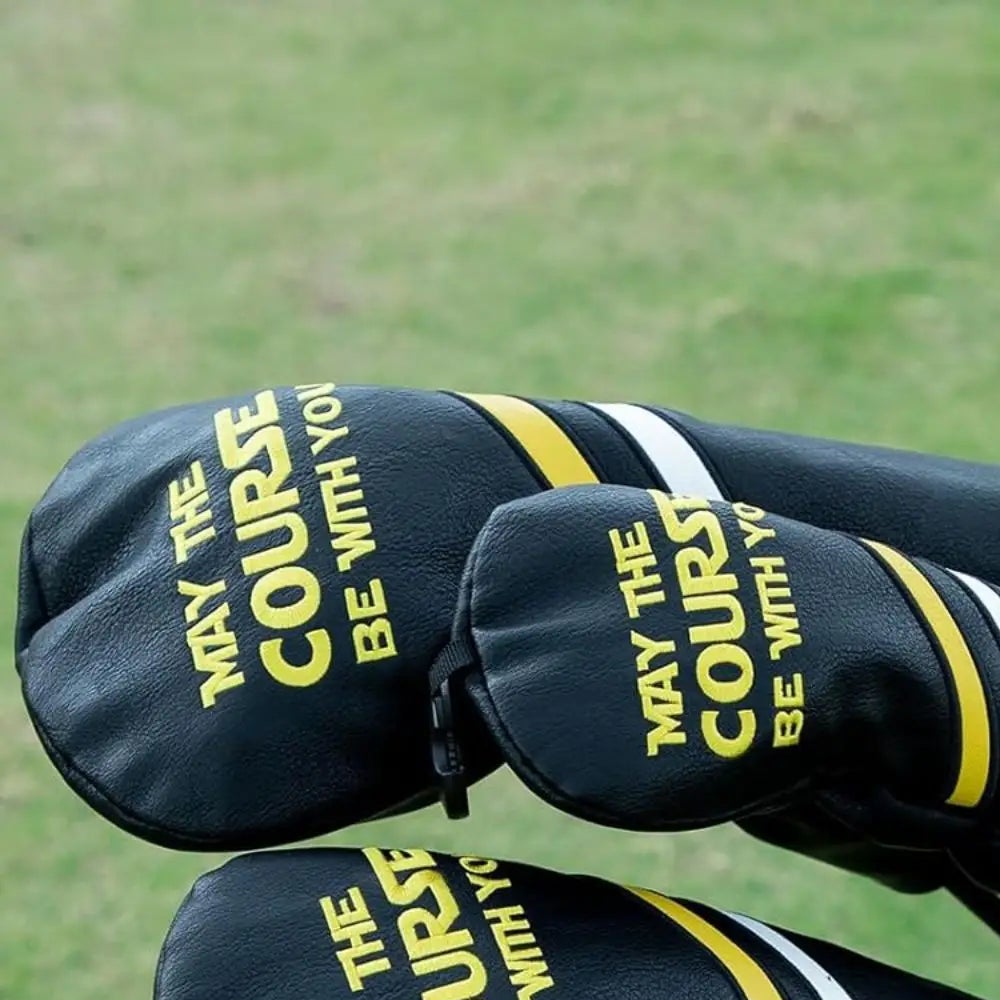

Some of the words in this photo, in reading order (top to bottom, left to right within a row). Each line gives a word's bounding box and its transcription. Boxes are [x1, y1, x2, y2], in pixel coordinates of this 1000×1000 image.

[168, 460, 216, 564] THE
[213, 389, 332, 687] COURSE
[315, 456, 376, 572] WITH
[732, 502, 776, 549] YO
[344, 578, 398, 664] BE
[608, 521, 666, 618] THE
[749, 556, 802, 660] WITH
[177, 580, 245, 708] MAY
[630, 630, 687, 756] MAY
[772, 673, 805, 747] BE
[459, 856, 512, 902] YO
[319, 887, 392, 992] THE
